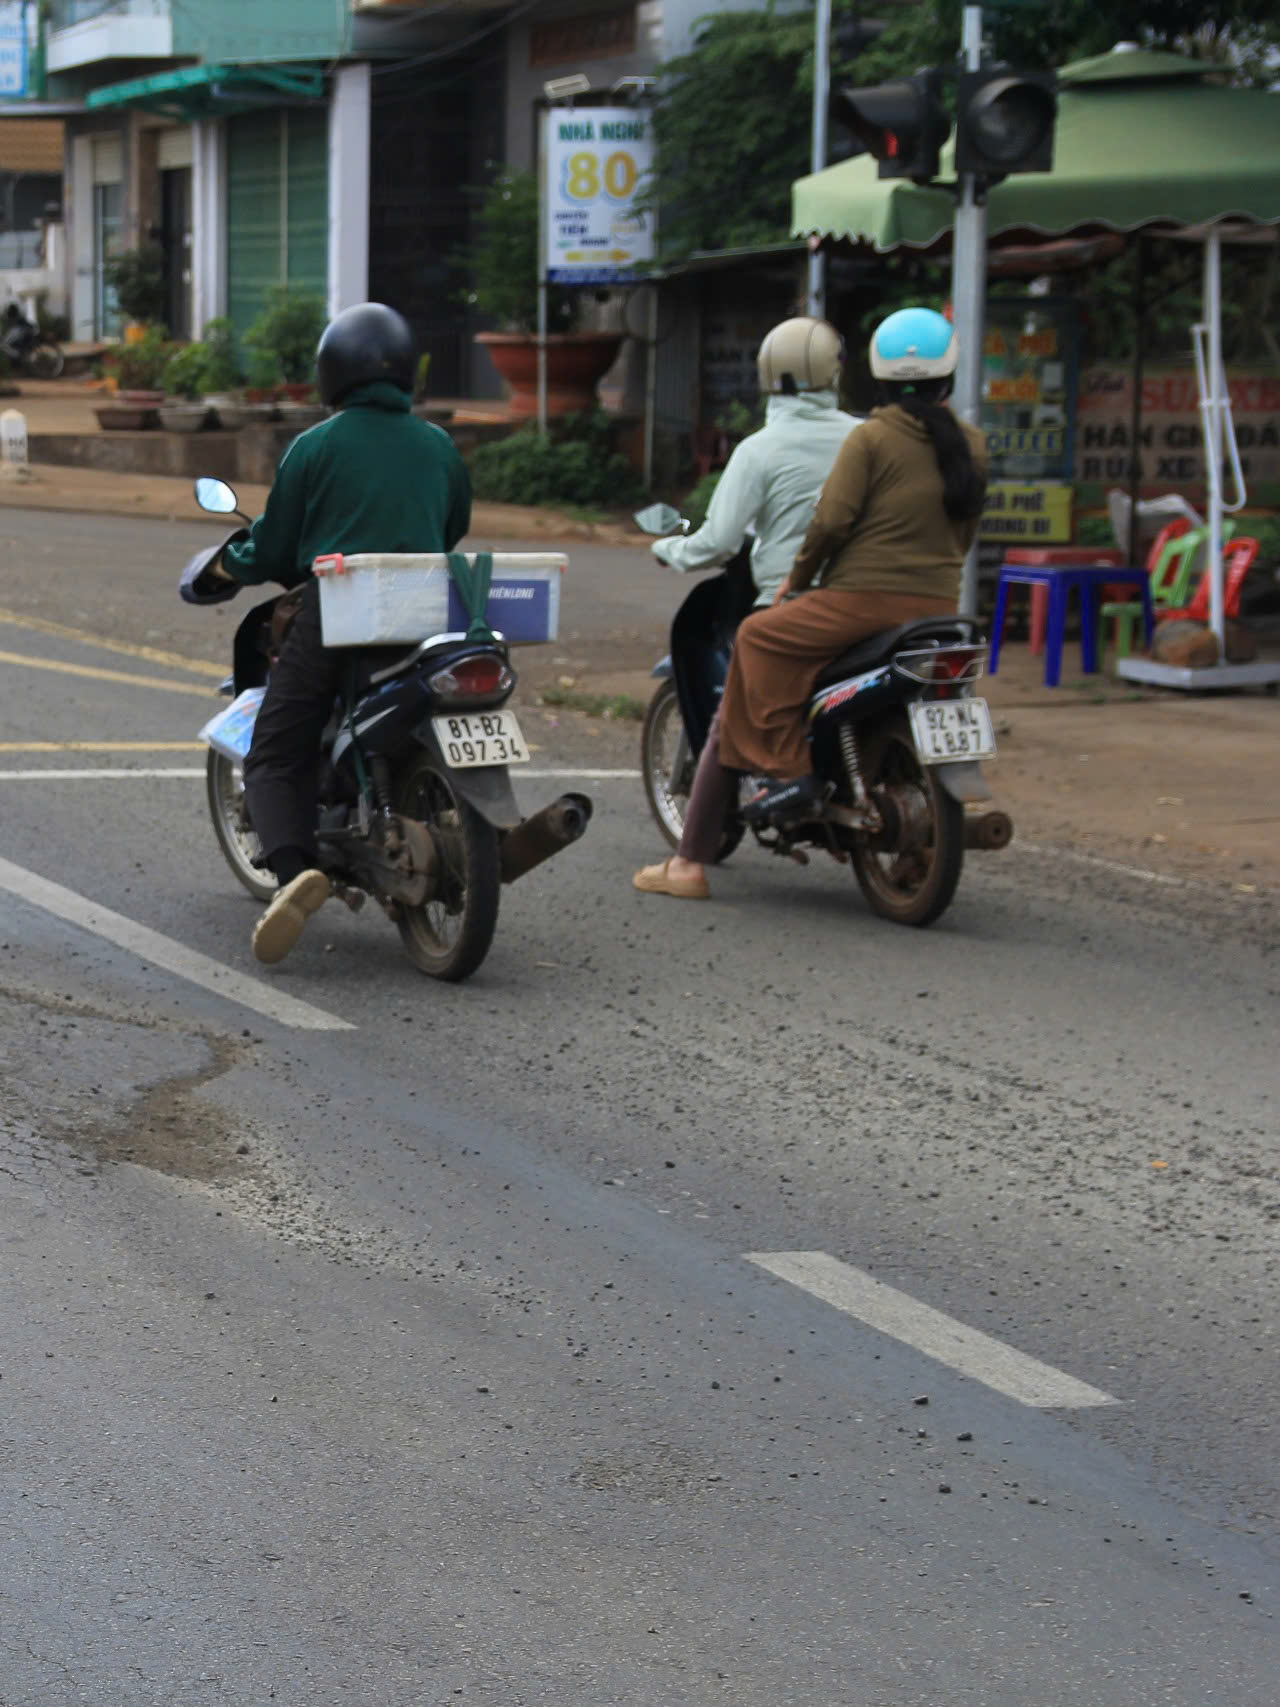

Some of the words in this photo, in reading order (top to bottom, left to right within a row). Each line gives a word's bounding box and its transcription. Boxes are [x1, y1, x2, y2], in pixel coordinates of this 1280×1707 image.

[567, 150, 638, 200] 80
[986, 430, 1057, 452] OFFEE
[448, 716, 507, 738] 81-B2
[448, 738, 522, 763] 097.34
